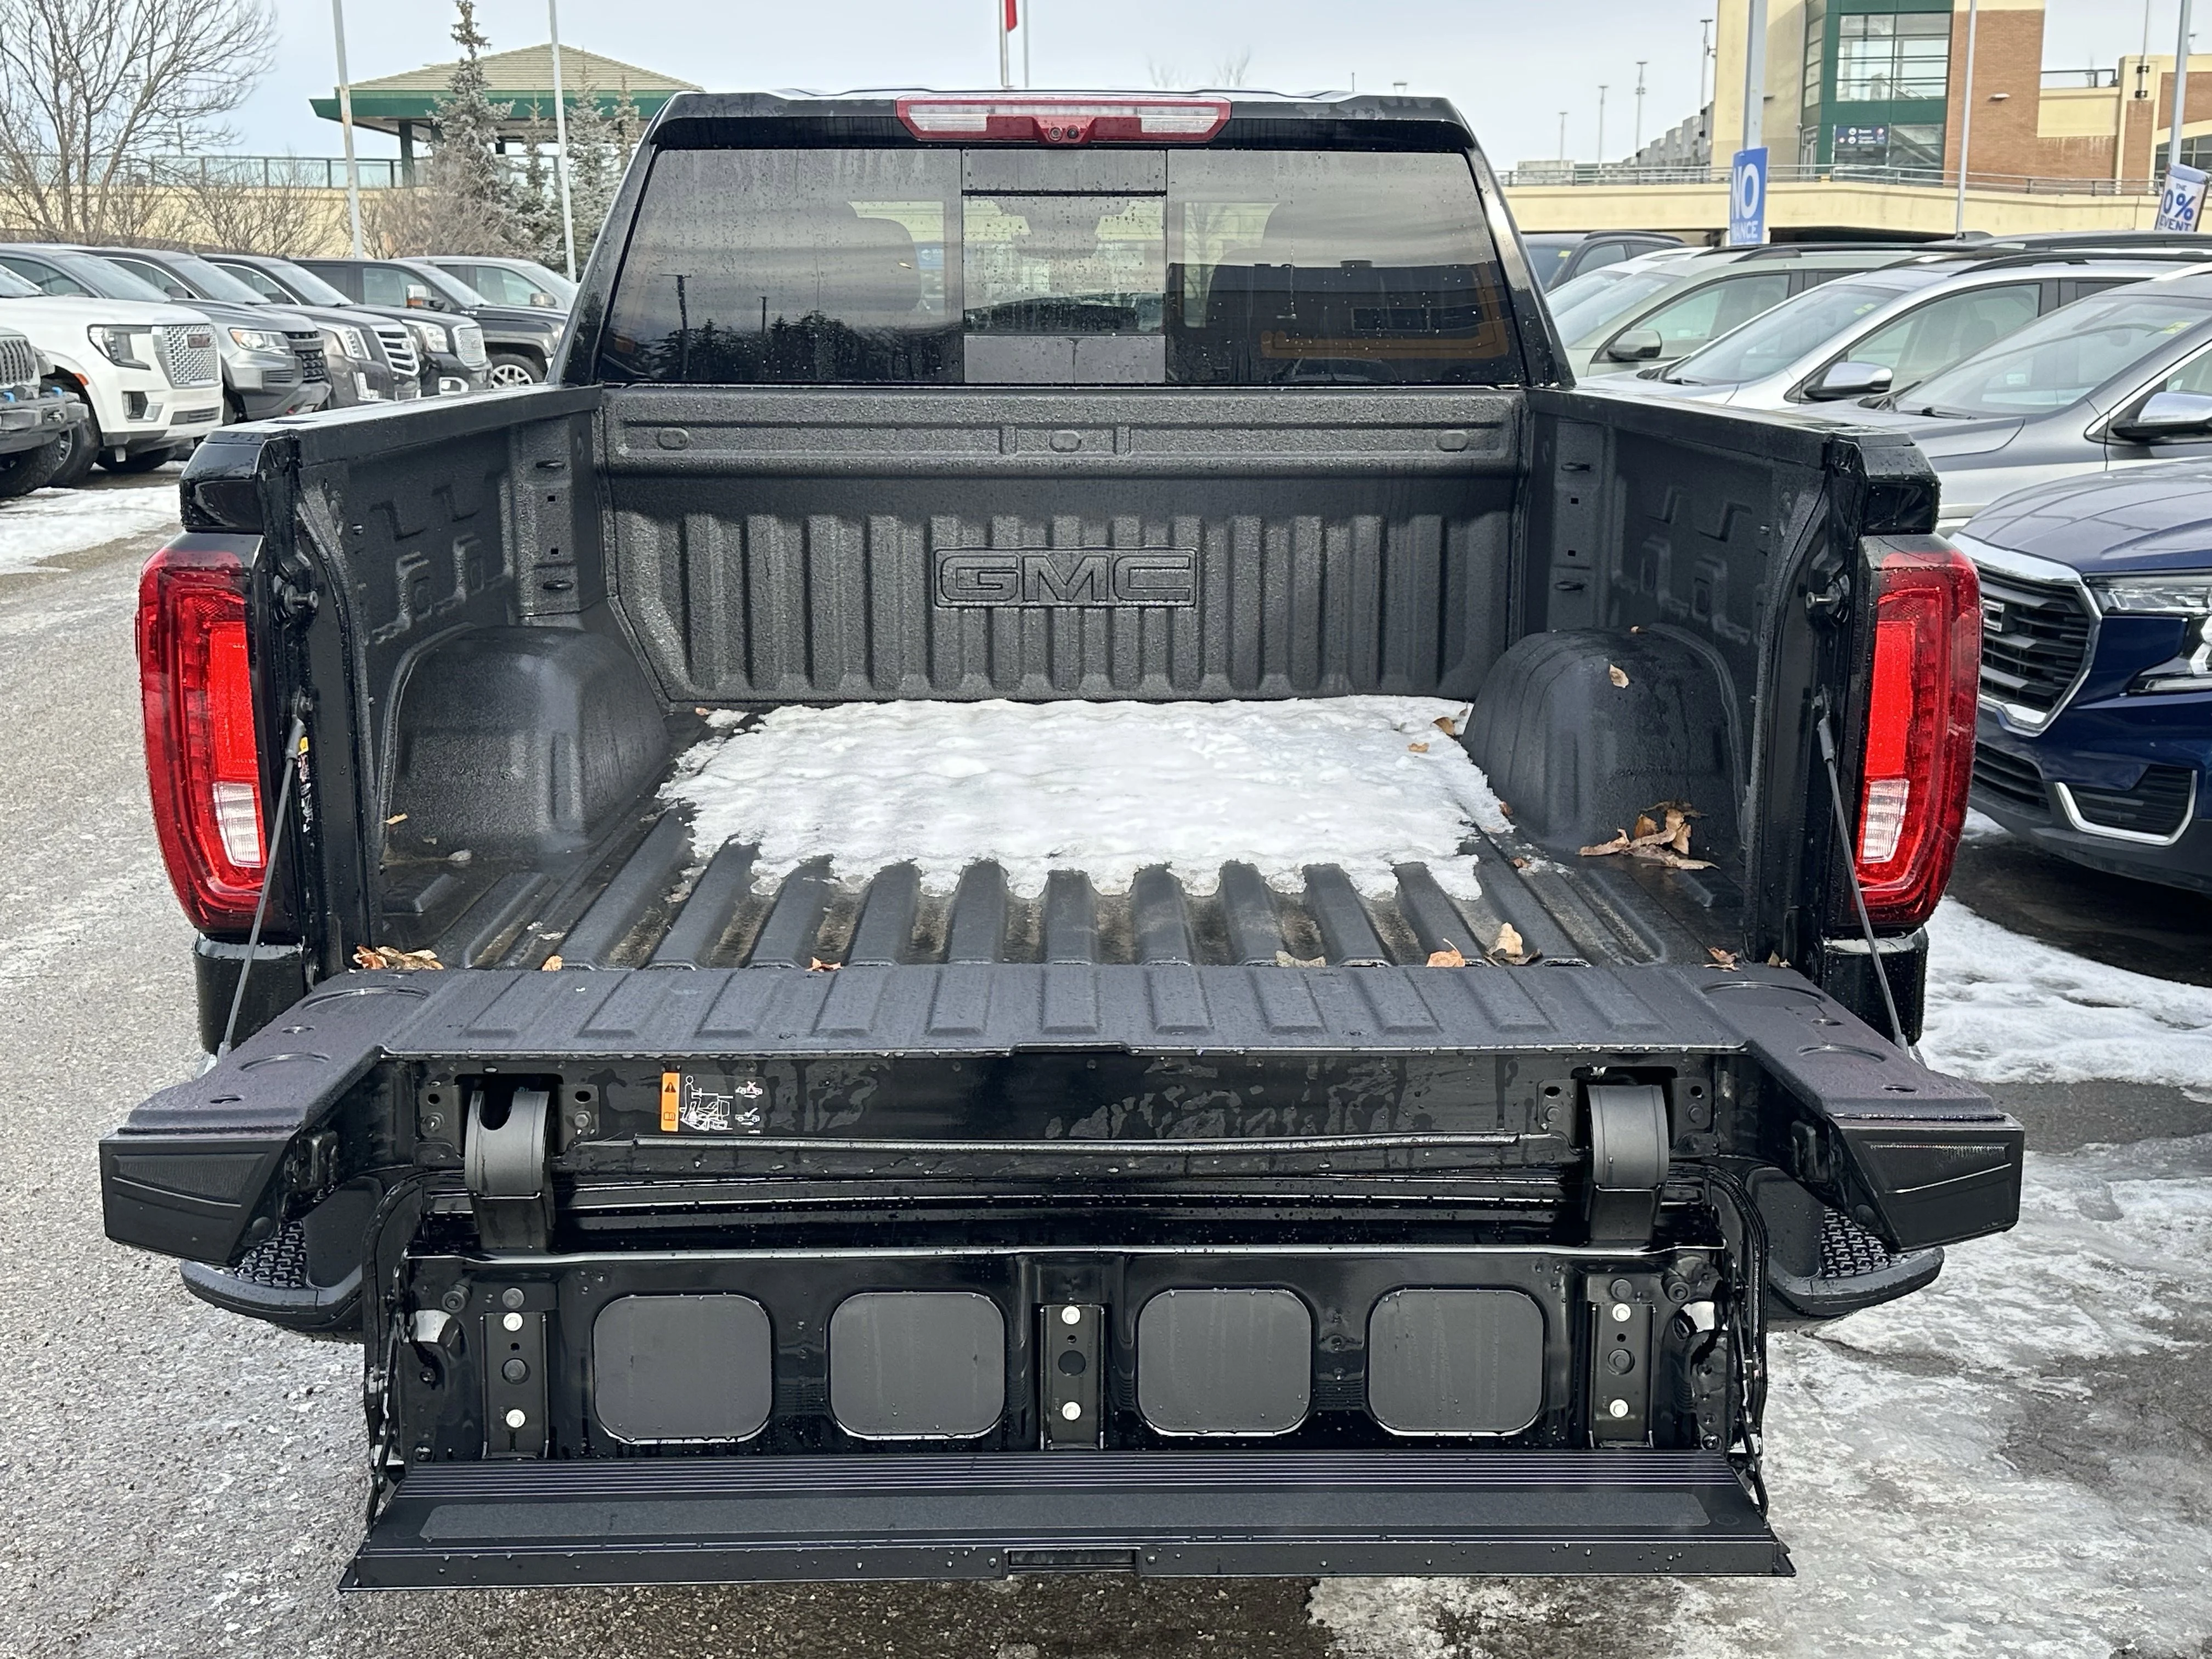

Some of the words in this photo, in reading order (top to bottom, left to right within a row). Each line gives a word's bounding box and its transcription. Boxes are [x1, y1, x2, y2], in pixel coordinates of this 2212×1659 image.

[1732, 163, 1759, 219] NO
[2163, 189, 2196, 221] 0%
[2159, 215, 2192, 231] EVENT
[941, 555, 1190, 602] GMC
